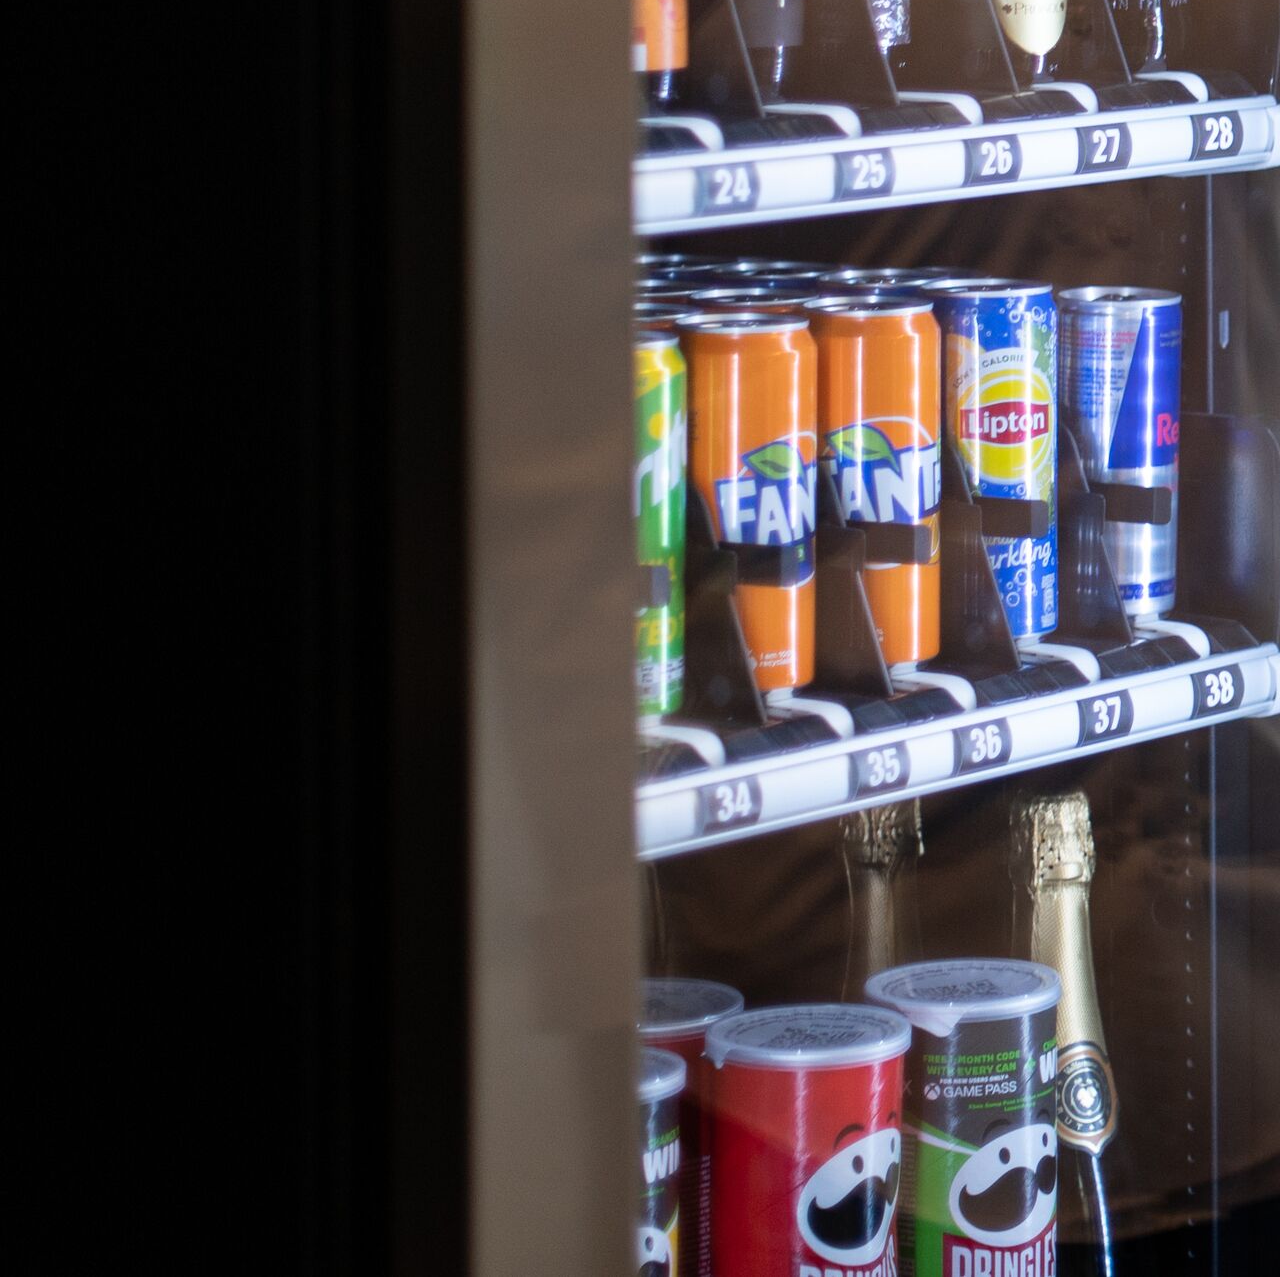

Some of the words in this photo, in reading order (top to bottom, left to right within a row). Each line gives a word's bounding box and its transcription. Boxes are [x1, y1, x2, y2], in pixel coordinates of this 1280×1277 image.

[714, 167, 750, 205] 24
[852, 153, 886, 190] 25
[980, 140, 1013, 176] 26
[1092, 129, 1120, 164] 27
[1205, 116, 1234, 151] 28
[968, 411, 1045, 438] Lipton
[715, 784, 752, 822] 34
[867, 748, 900, 787] 35
[970, 724, 1002, 762] 36
[1093, 696, 1122, 734] 37
[1205, 670, 1234, 707] 38
[996, 1049, 1021, 1061] CODE
[957, 1064, 993, 1076] EVERY
[996, 1060, 1016, 1072] CAN
[943, 1084, 983, 1099] GAME
[985, 1080, 1017, 1095] PASS
